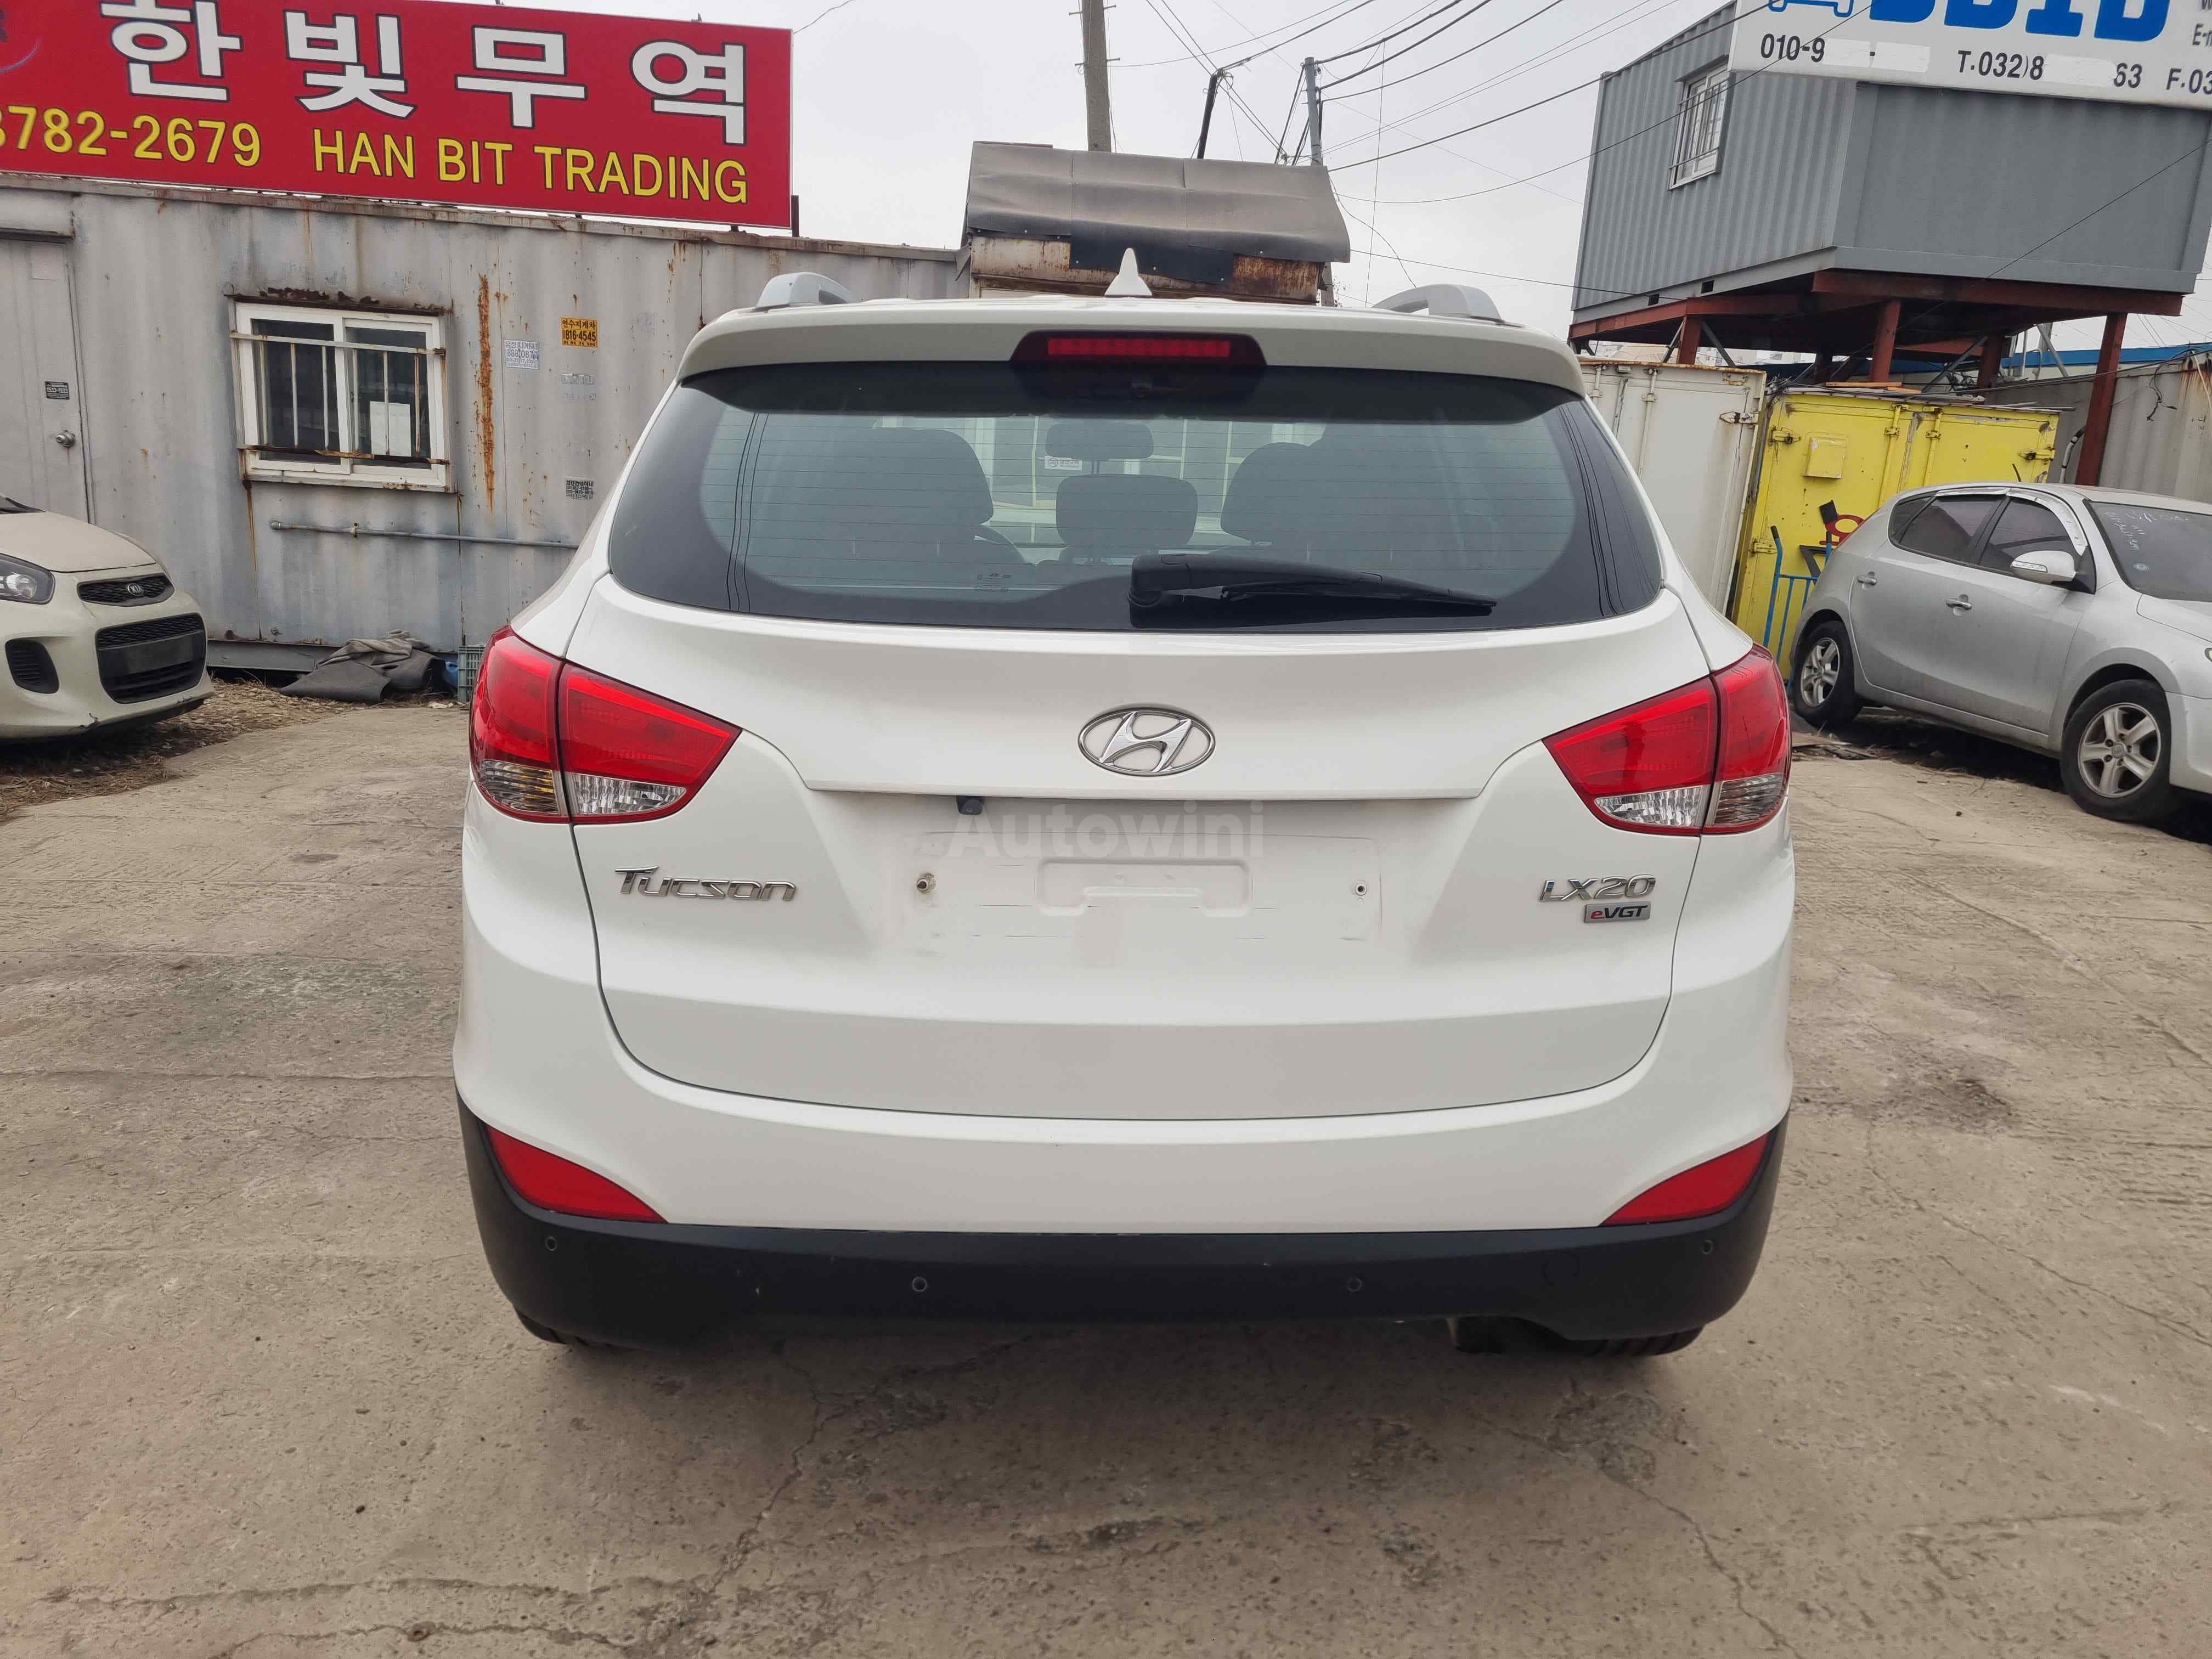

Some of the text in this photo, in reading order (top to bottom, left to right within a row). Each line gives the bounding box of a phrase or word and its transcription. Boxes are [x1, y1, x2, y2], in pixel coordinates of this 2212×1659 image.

[0, 105, 747, 204] 782-2679 HAN BIT TRADING
[614, 865, 797, 901] Tucson
[1539, 874, 1656, 901] LX20
[1590, 905, 1648, 919] eVGT
